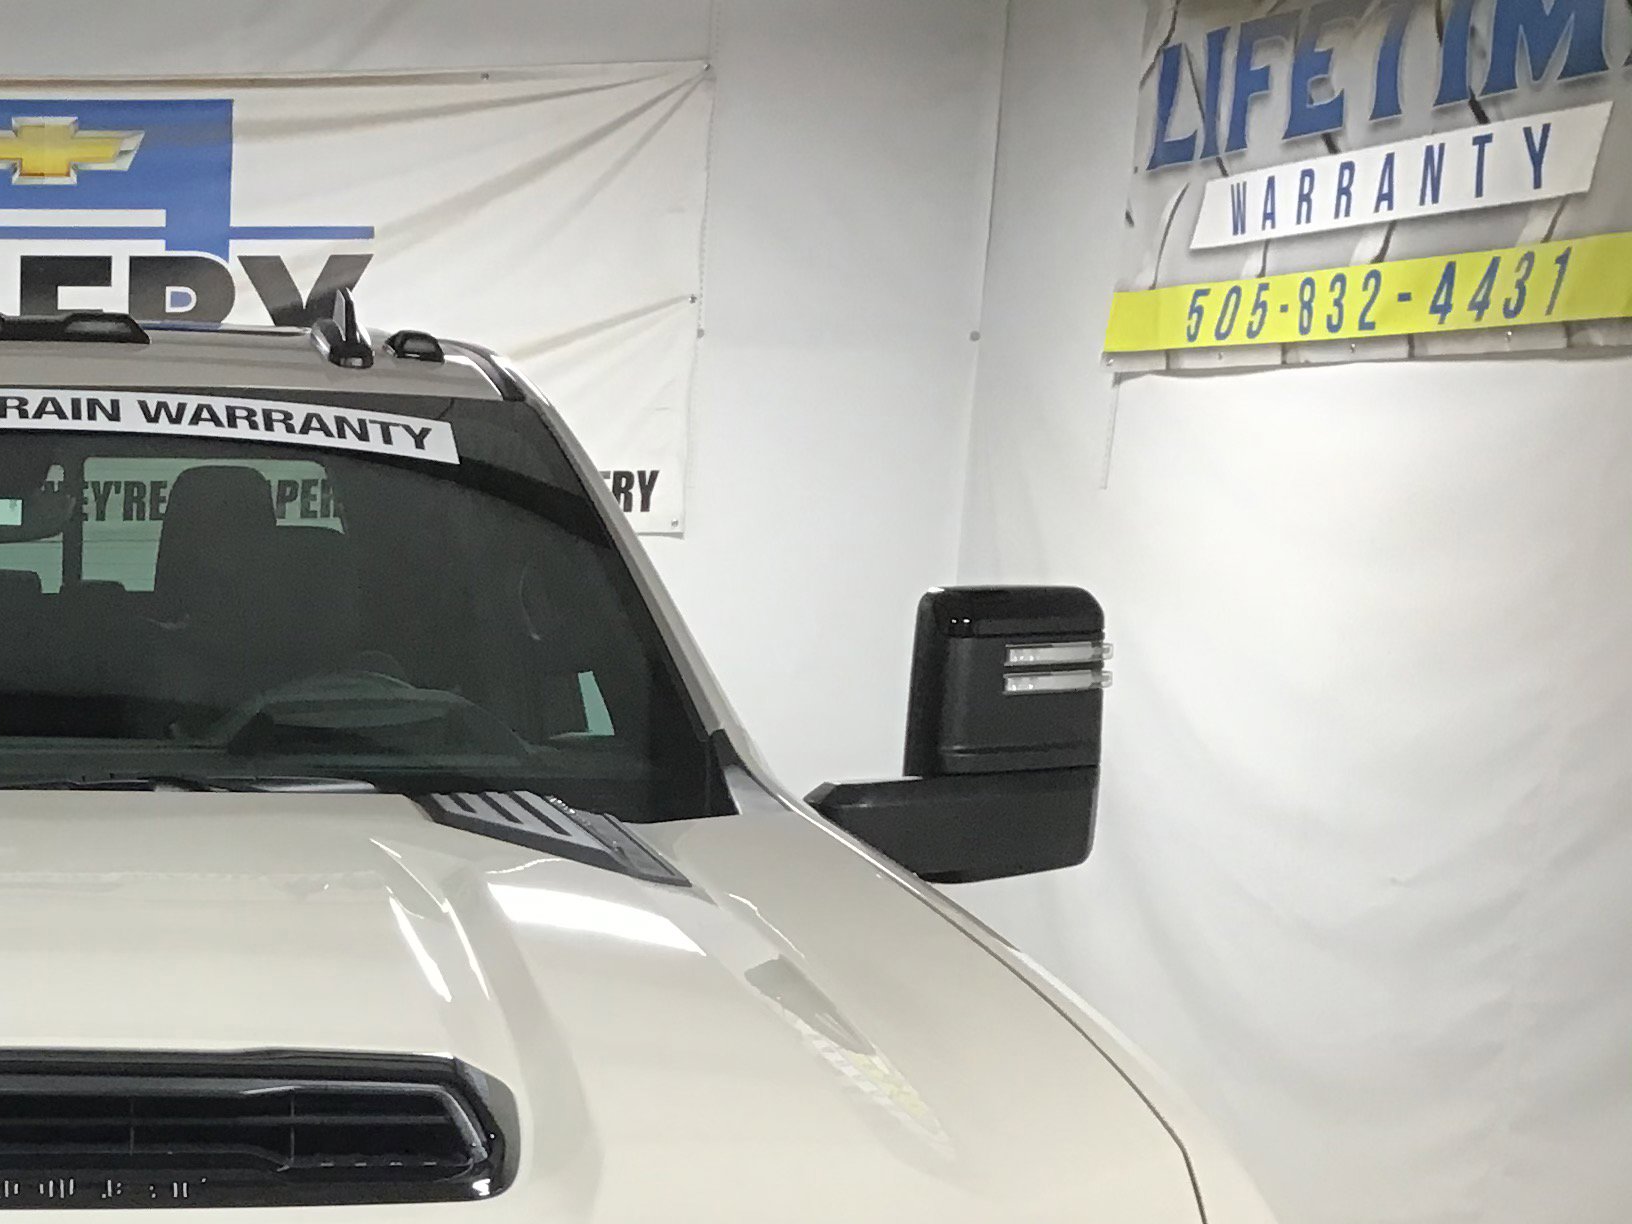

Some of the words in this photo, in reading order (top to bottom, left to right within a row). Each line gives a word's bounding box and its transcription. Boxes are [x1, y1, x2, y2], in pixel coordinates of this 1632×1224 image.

[1146, 0, 1632, 171] LIFETIM
[1230, 122, 1552, 236] WARRANTY
[1186, 246, 1573, 343] 505-832-4431
[136, 399, 433, 451] WARRANTY
